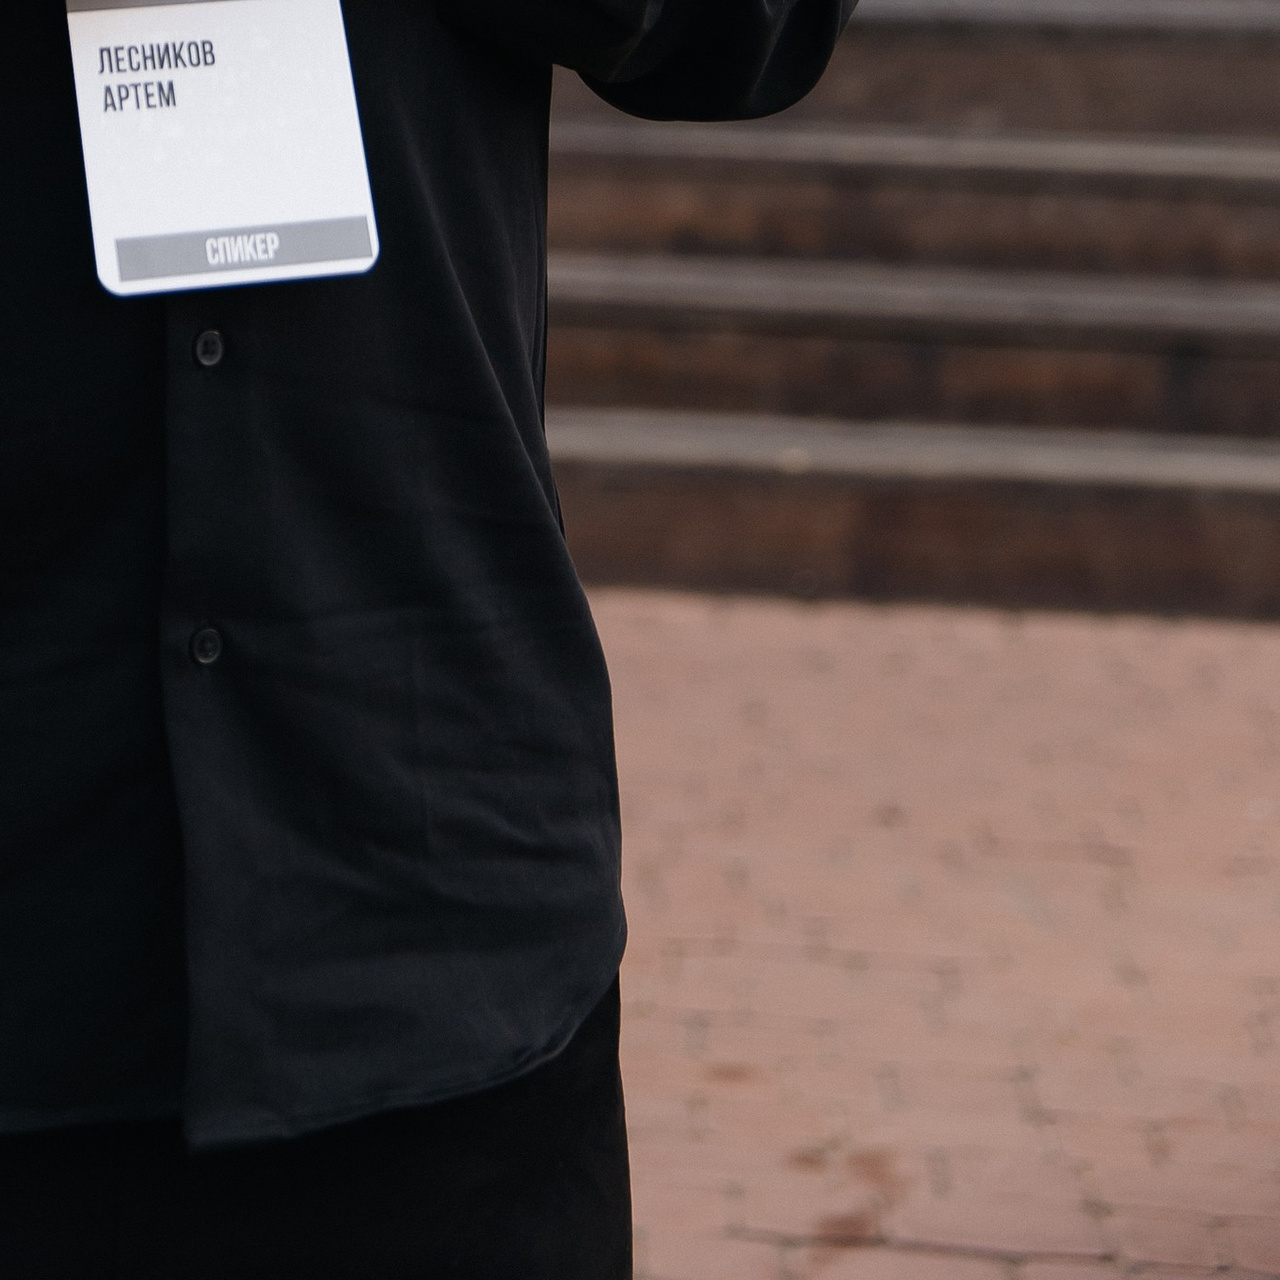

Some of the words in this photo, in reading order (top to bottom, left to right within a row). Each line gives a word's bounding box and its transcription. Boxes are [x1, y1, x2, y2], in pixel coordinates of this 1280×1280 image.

[98, 40, 216, 75] ЛЕСНИКОВ
[103, 80, 177, 112] АРТЕМ
[205, 232, 279, 265] СПИКЕР
